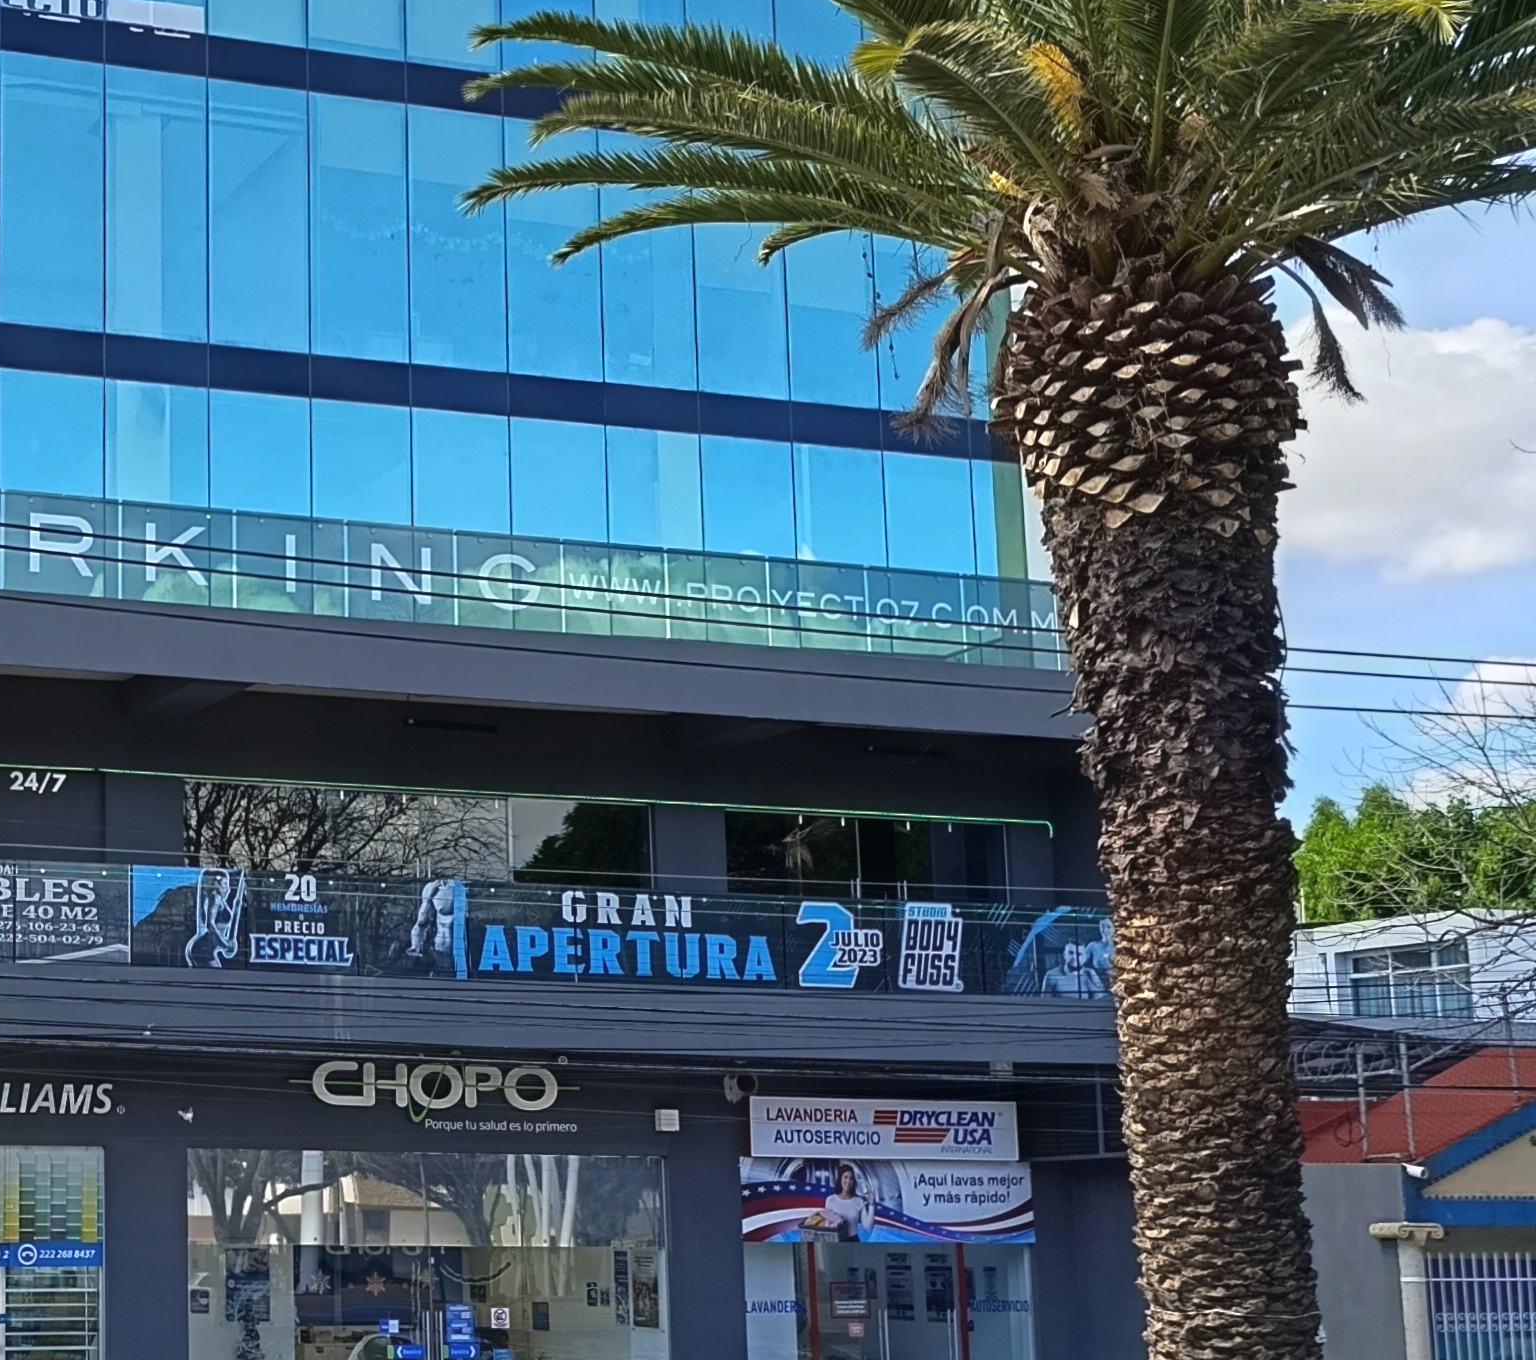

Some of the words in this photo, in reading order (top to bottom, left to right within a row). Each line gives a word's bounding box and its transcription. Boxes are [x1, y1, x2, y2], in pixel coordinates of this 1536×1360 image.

[9, 771, 66, 794] 24/7
[285, 874, 316, 902] 20
[22, 904, 54, 919] 40
[60, 906, 98, 921] M2
[562, 890, 692, 928] GRAN
[908, 906, 947, 918] STUDIO
[274, 920, 325, 934] PRECIO
[796, 901, 859, 988] 2
[830, 931, 881, 948] JULIO
[254, 936, 351, 963] ESPECIAL
[478, 925, 777, 981] APERTURA
[838, 948, 878, 965] 2023
[902, 952, 956, 986] FUSS
[312, 1060, 558, 1111] CHOPO
[766, 1107, 858, 1123] LAVANDERIA
[899, 1110, 996, 1127] DRYCLEAN
[425, 1118, 463, 1131] Porque
[465, 1119, 477, 1131] tu
[479, 1120, 507, 1131] salud
[509, 1122, 521, 1131] es
[523, 1121, 534, 1132] lo
[535, 1121, 578, 1133] primero
[774, 1129, 881, 1145] AUTOSERVICIO
[952, 1128, 993, 1145] USA
[951, 1173, 984, 1187] lavas
[987, 1173, 1025, 1189] mejor
[923, 1192, 931, 1206] y
[934, 1191, 961, 1203] más
[965, 1191, 1010, 1206] rápido!
[745, 1300, 807, 1313] LAVANDER
